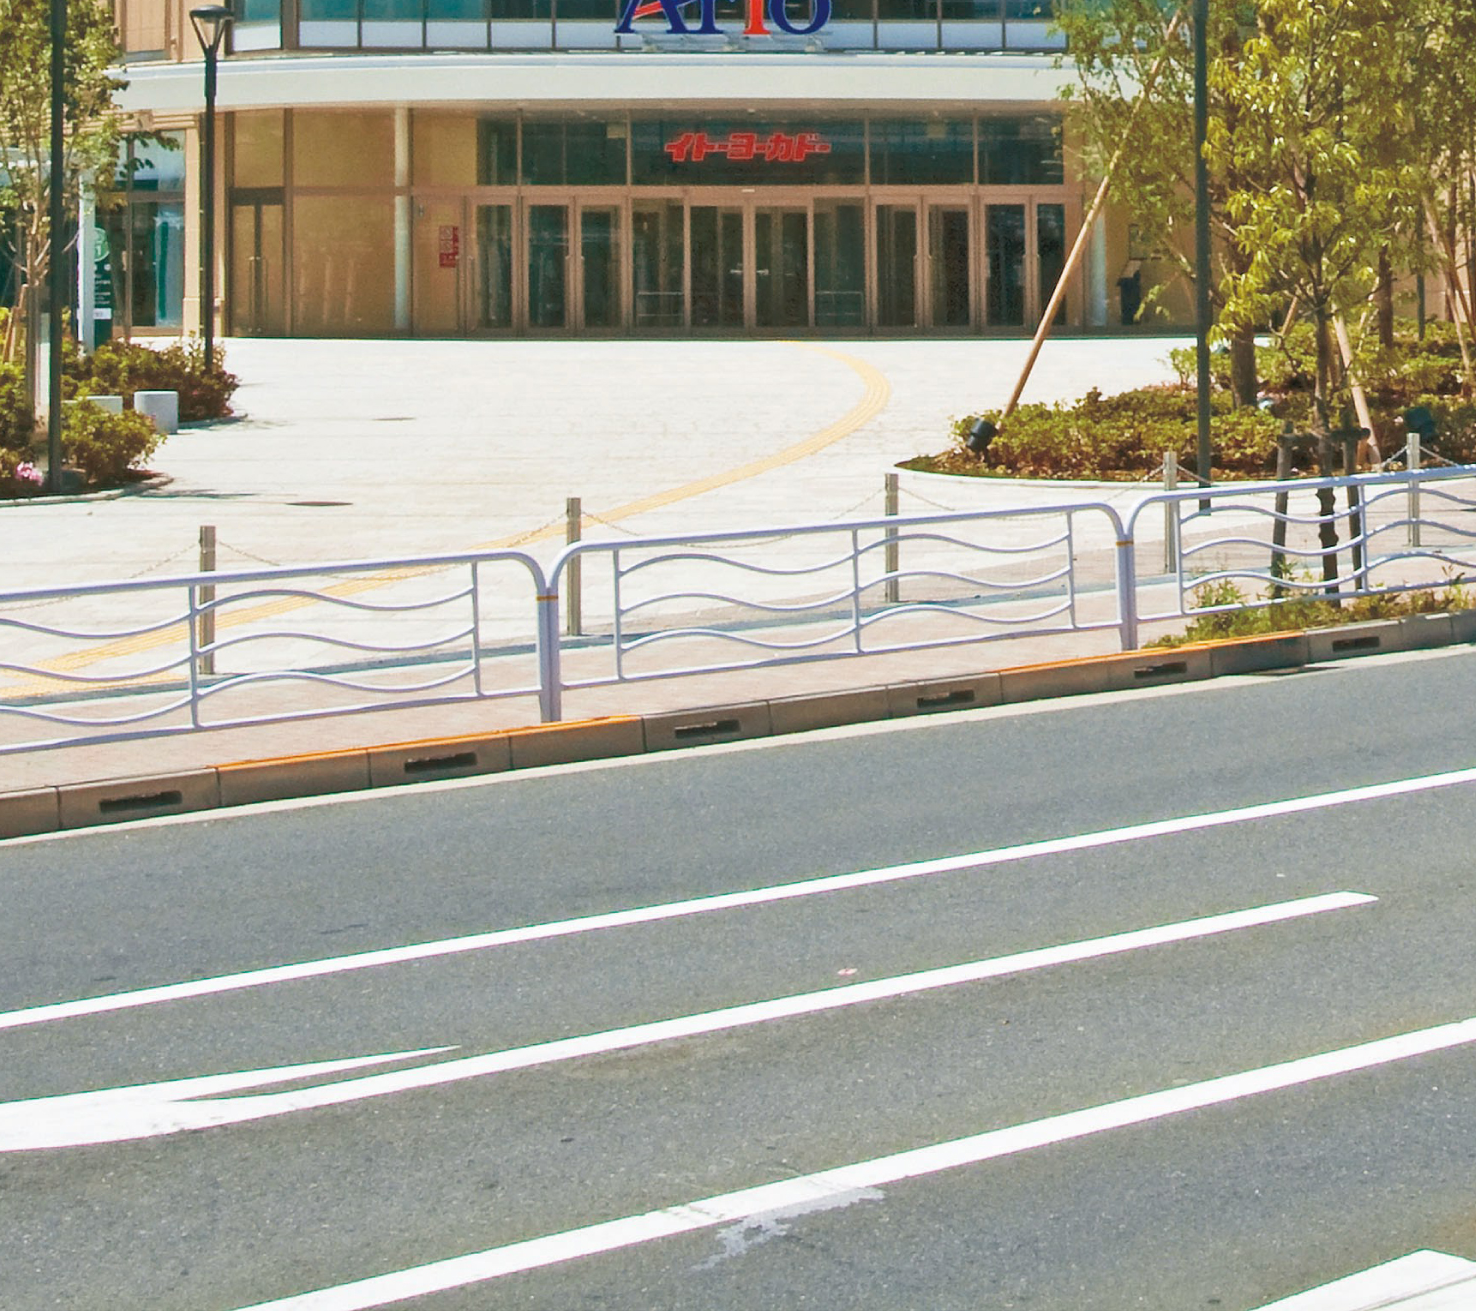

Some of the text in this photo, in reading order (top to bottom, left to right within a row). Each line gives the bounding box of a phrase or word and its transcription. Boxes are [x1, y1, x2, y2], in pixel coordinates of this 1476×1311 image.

[664, 132, 832, 162] イトーヨーカドー
